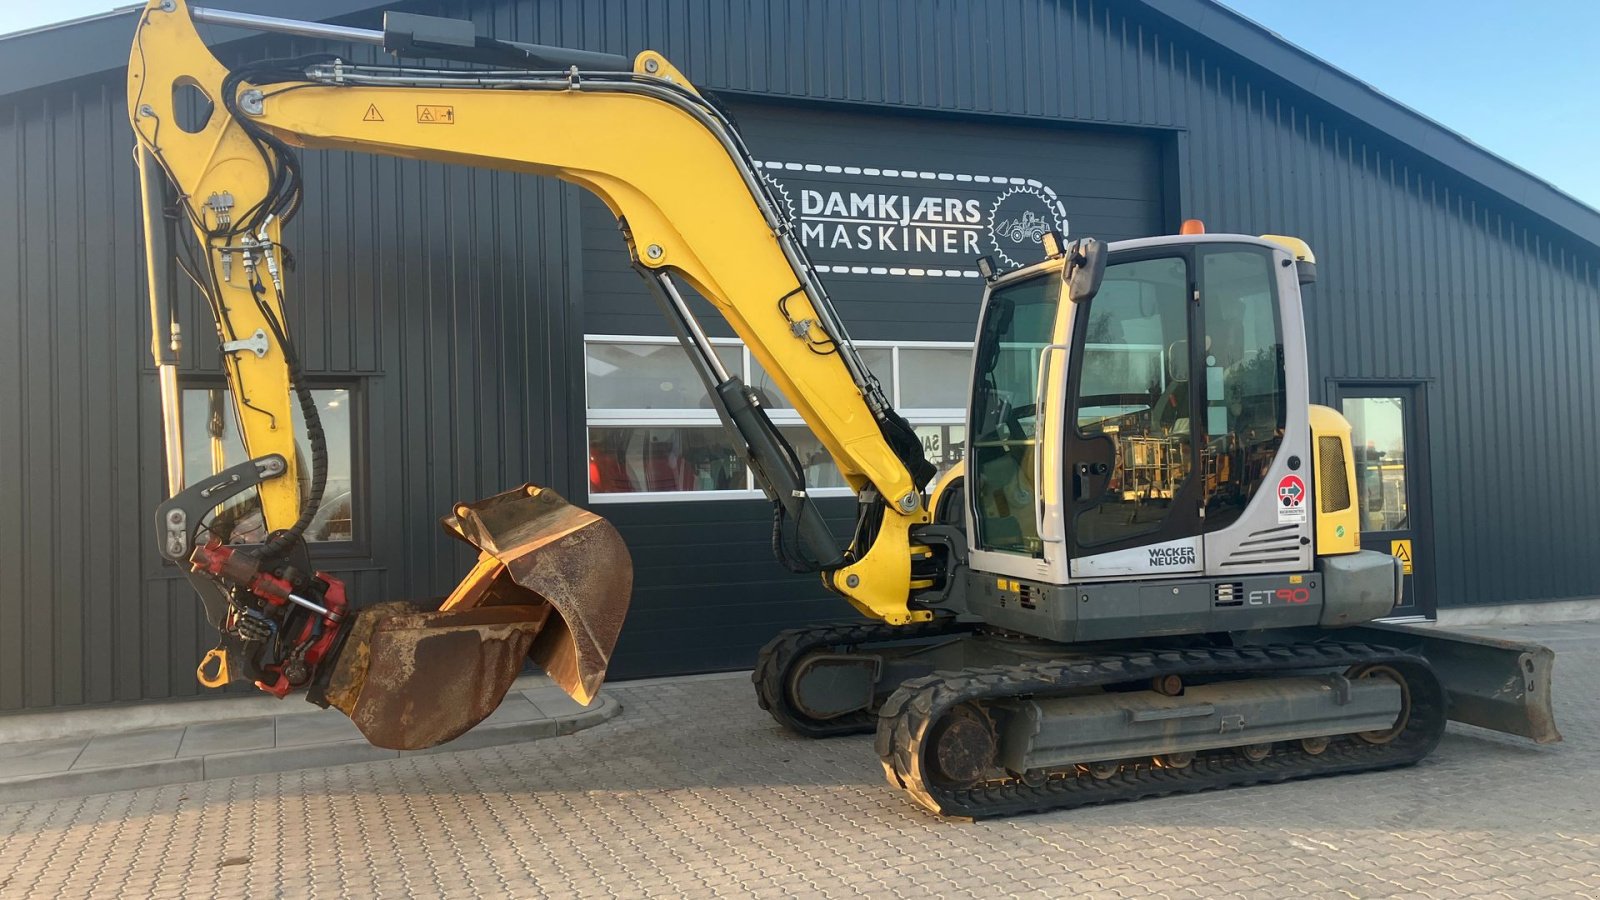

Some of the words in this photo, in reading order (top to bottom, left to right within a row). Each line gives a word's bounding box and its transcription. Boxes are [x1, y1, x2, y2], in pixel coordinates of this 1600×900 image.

[801, 189, 981, 226] DAMKJÆRS
[801, 222, 981, 255] MASKINER
[1148, 546, 1195, 557] WACKER
[1149, 556, 1196, 566] NEUSON
[1249, 588, 1310, 605] ET90
